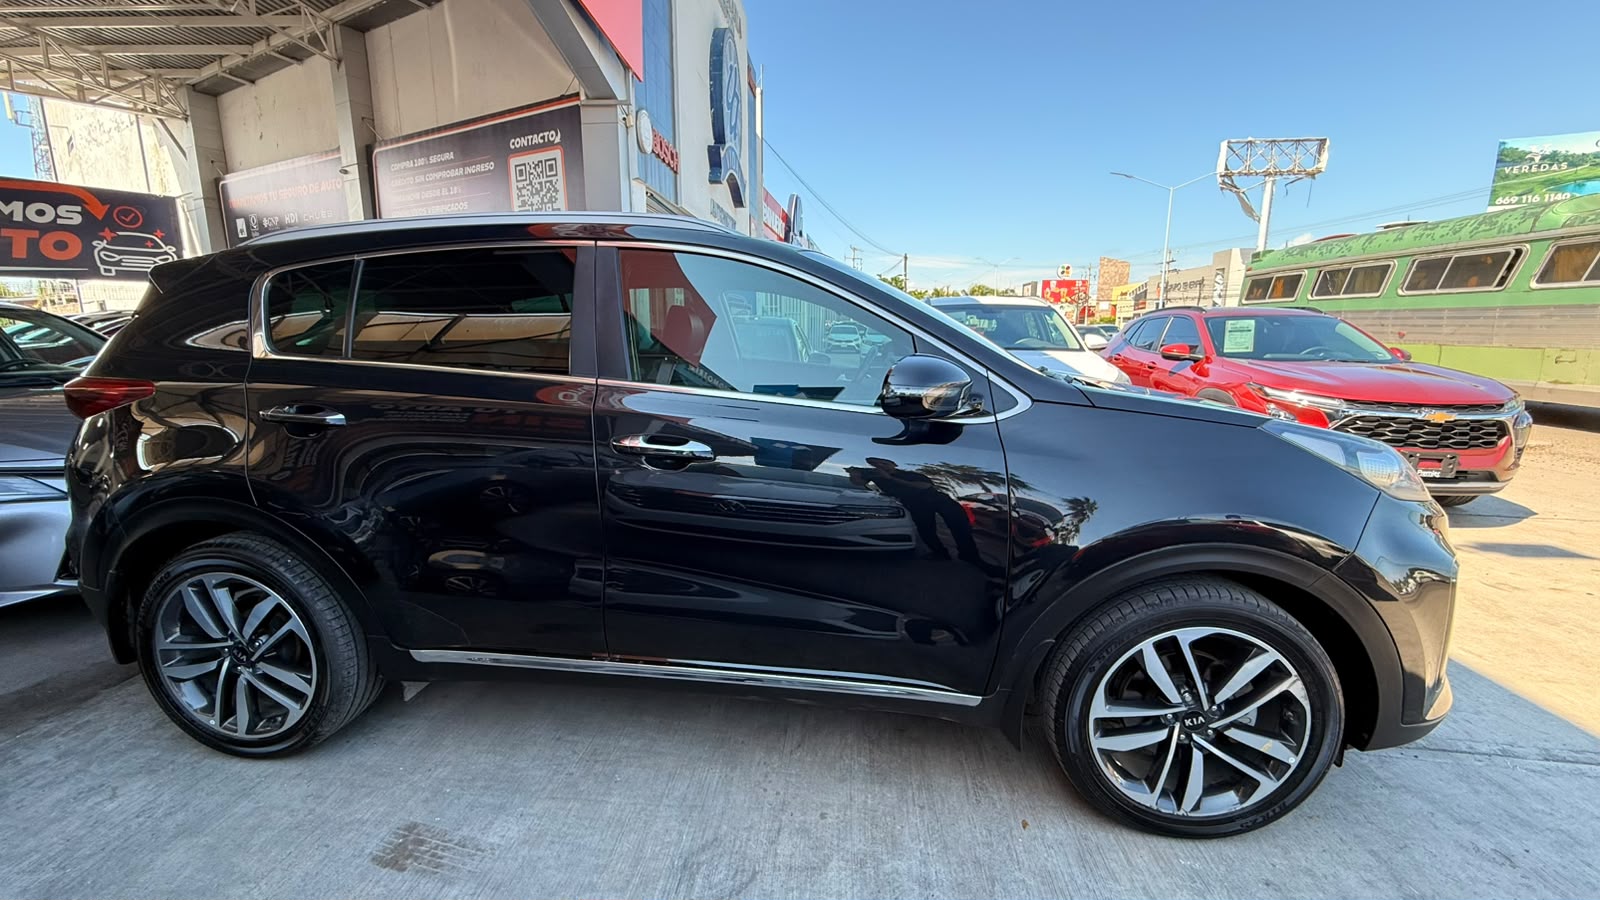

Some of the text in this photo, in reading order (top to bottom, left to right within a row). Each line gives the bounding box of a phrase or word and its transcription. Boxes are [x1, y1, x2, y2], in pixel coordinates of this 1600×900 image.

[509, 131, 555, 149] CONTACTO
[652, 127, 679, 174] BOSCH
[391, 160, 413, 171] COMPRA
[429, 151, 454, 164] SEGURA
[1504, 162, 1568, 174] VEREDAS
[425, 168, 463, 182] COMPROBAR
[464, 162, 495, 174] INGRESO
[309, 183, 320, 194] DE
[320, 178, 342, 193] AUTO
[1495, 192, 1571, 205] 669 116 1140
[0, 201, 82, 225] MOS
[284, 212, 298, 224] HDI
[1, 228, 82, 260] TO
[1184, 716, 1205, 727] KIA
